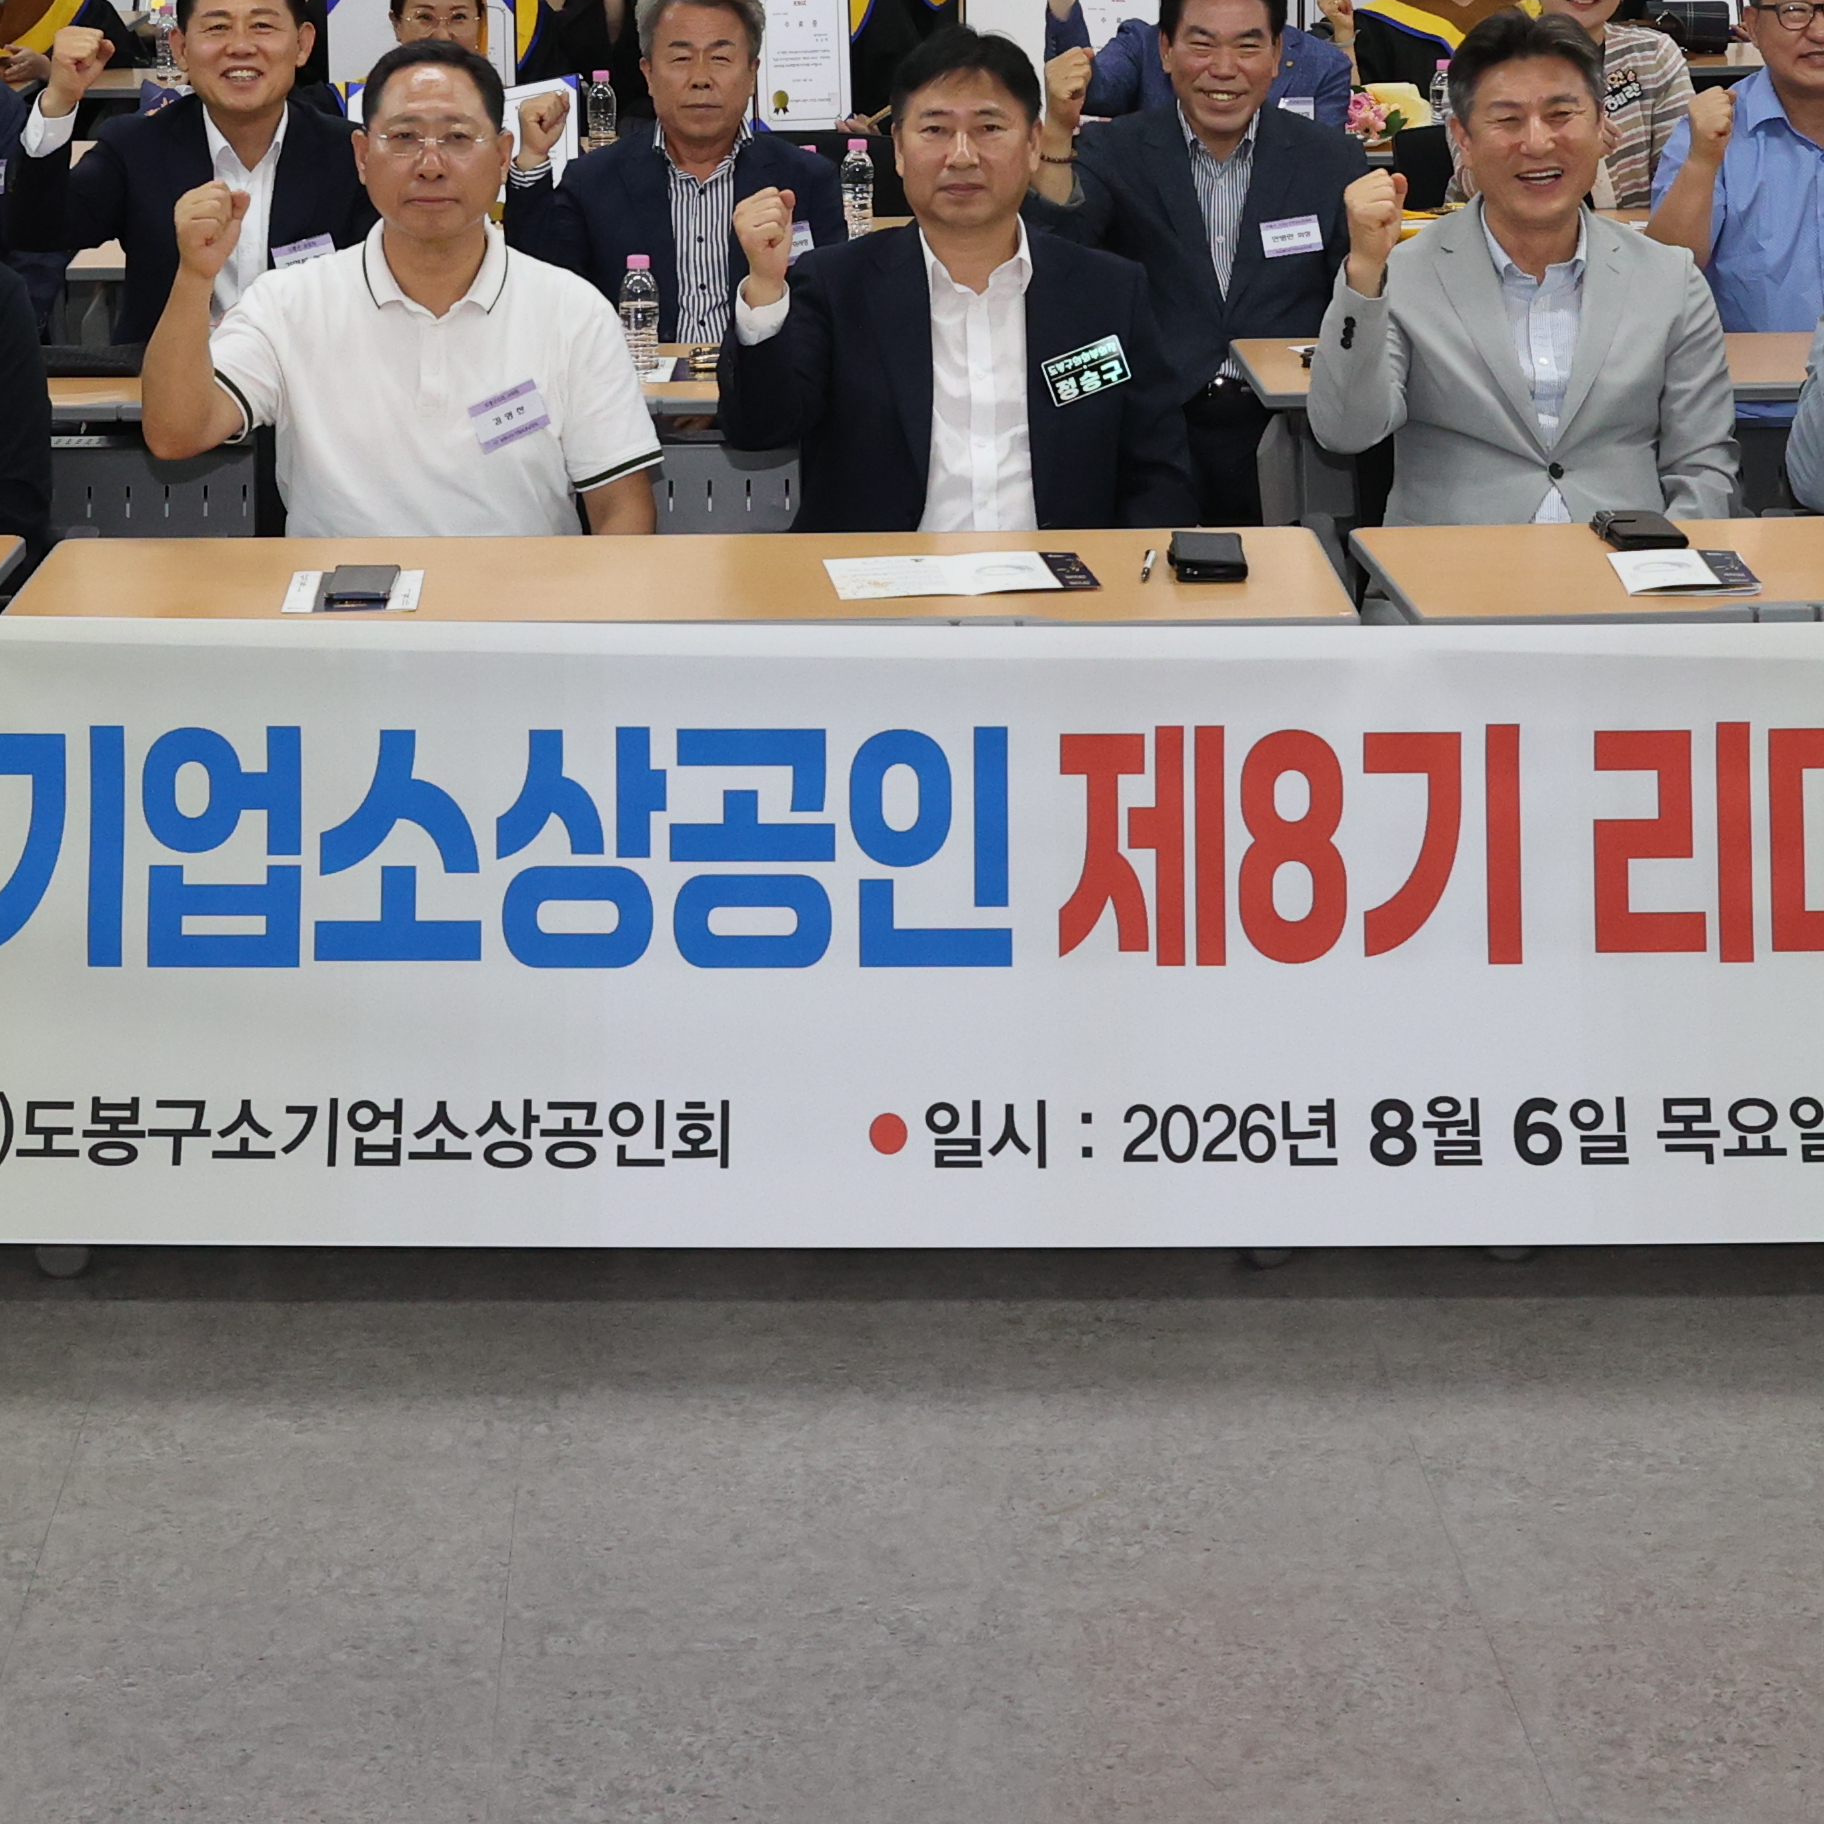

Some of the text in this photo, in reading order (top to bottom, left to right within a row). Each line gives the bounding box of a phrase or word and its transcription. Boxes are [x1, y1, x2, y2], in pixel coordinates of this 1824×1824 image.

[1055, 360, 1123, 401] 정승구
[1060, 725, 1522, 965] 제8기
[926, 1100, 1046, 1168] 일시
[1124, 1099, 1337, 1166] 2026년
[1370, 1096, 1482, 1166] 8월
[1514, 1097, 1629, 1165] 6일
